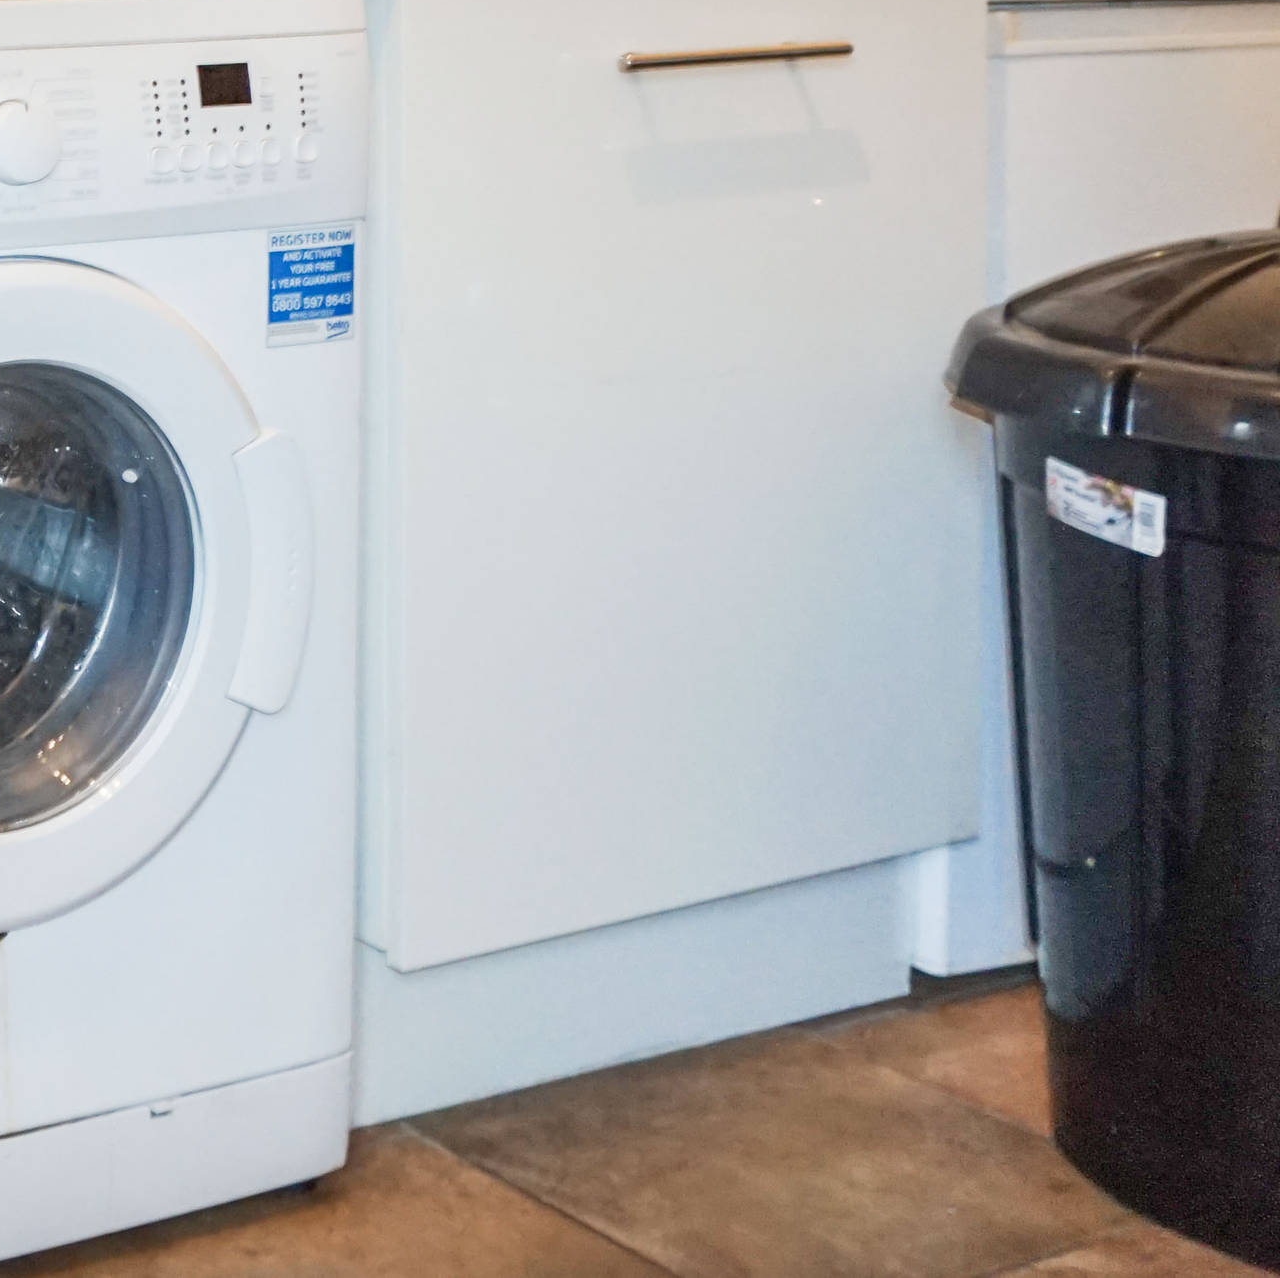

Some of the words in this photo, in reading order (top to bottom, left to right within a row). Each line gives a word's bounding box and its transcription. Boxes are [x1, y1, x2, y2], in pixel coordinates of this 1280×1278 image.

[271, 232, 325, 247] REGISTER
[328, 230, 352, 242] NOW
[290, 263, 314, 274] YOUR
[278, 277, 301, 288] YEAR
[302, 272, 352, 286] GUARANTEE
[272, 298, 301, 312] 0800
